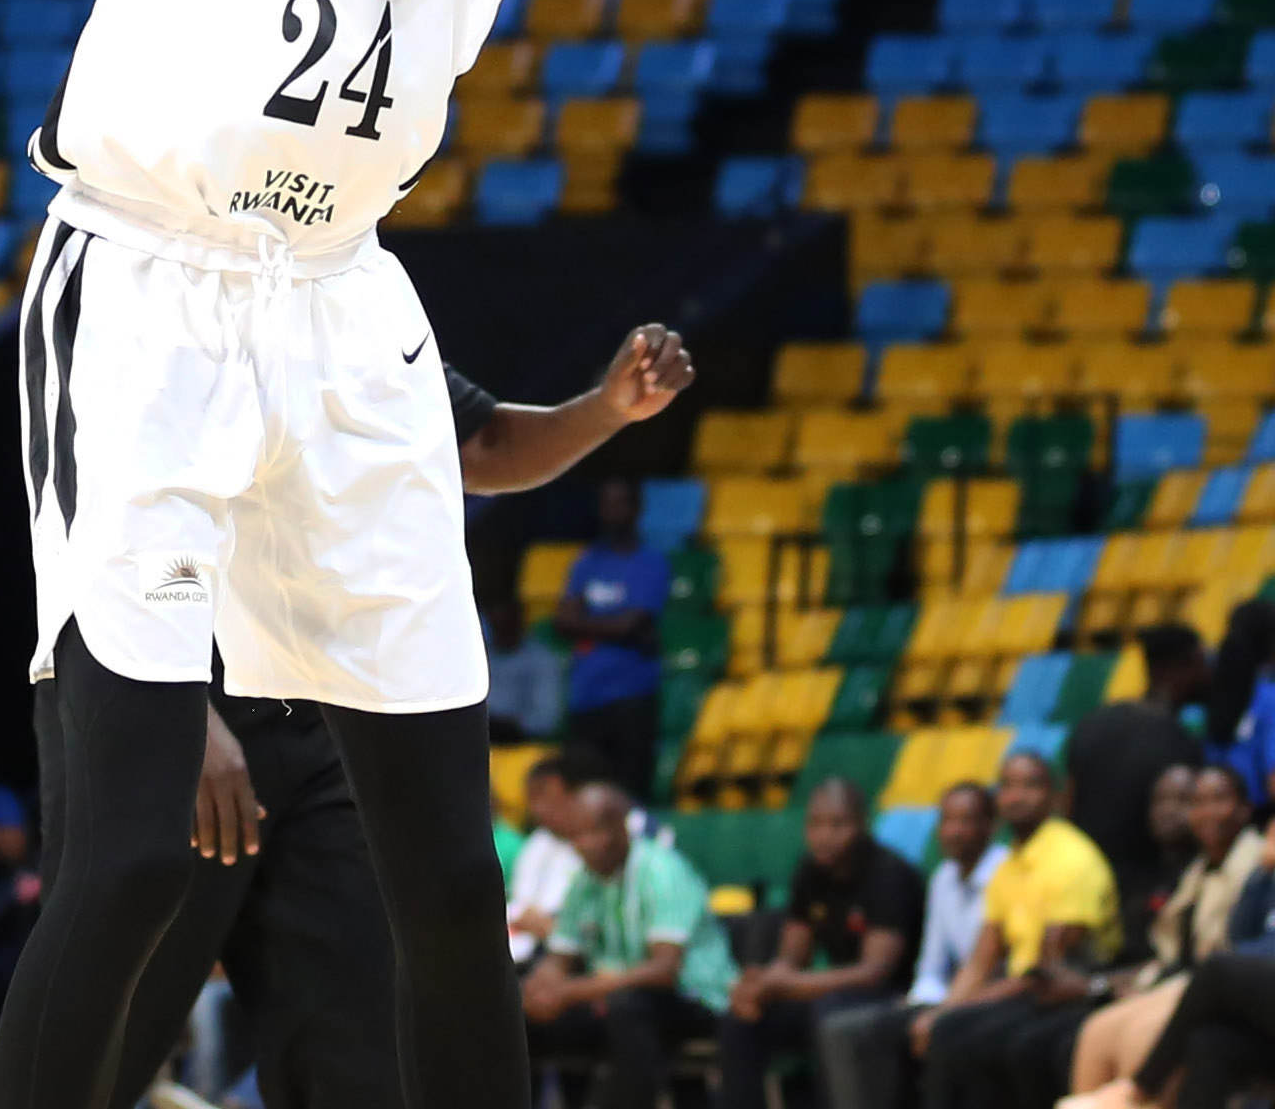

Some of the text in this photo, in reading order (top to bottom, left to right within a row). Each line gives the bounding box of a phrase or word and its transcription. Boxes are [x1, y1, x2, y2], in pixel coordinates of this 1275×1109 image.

[265, 169, 335, 205] VISIT
[229, 191, 335, 226] RWANDA
[145, 591, 191, 602] RWANDA
